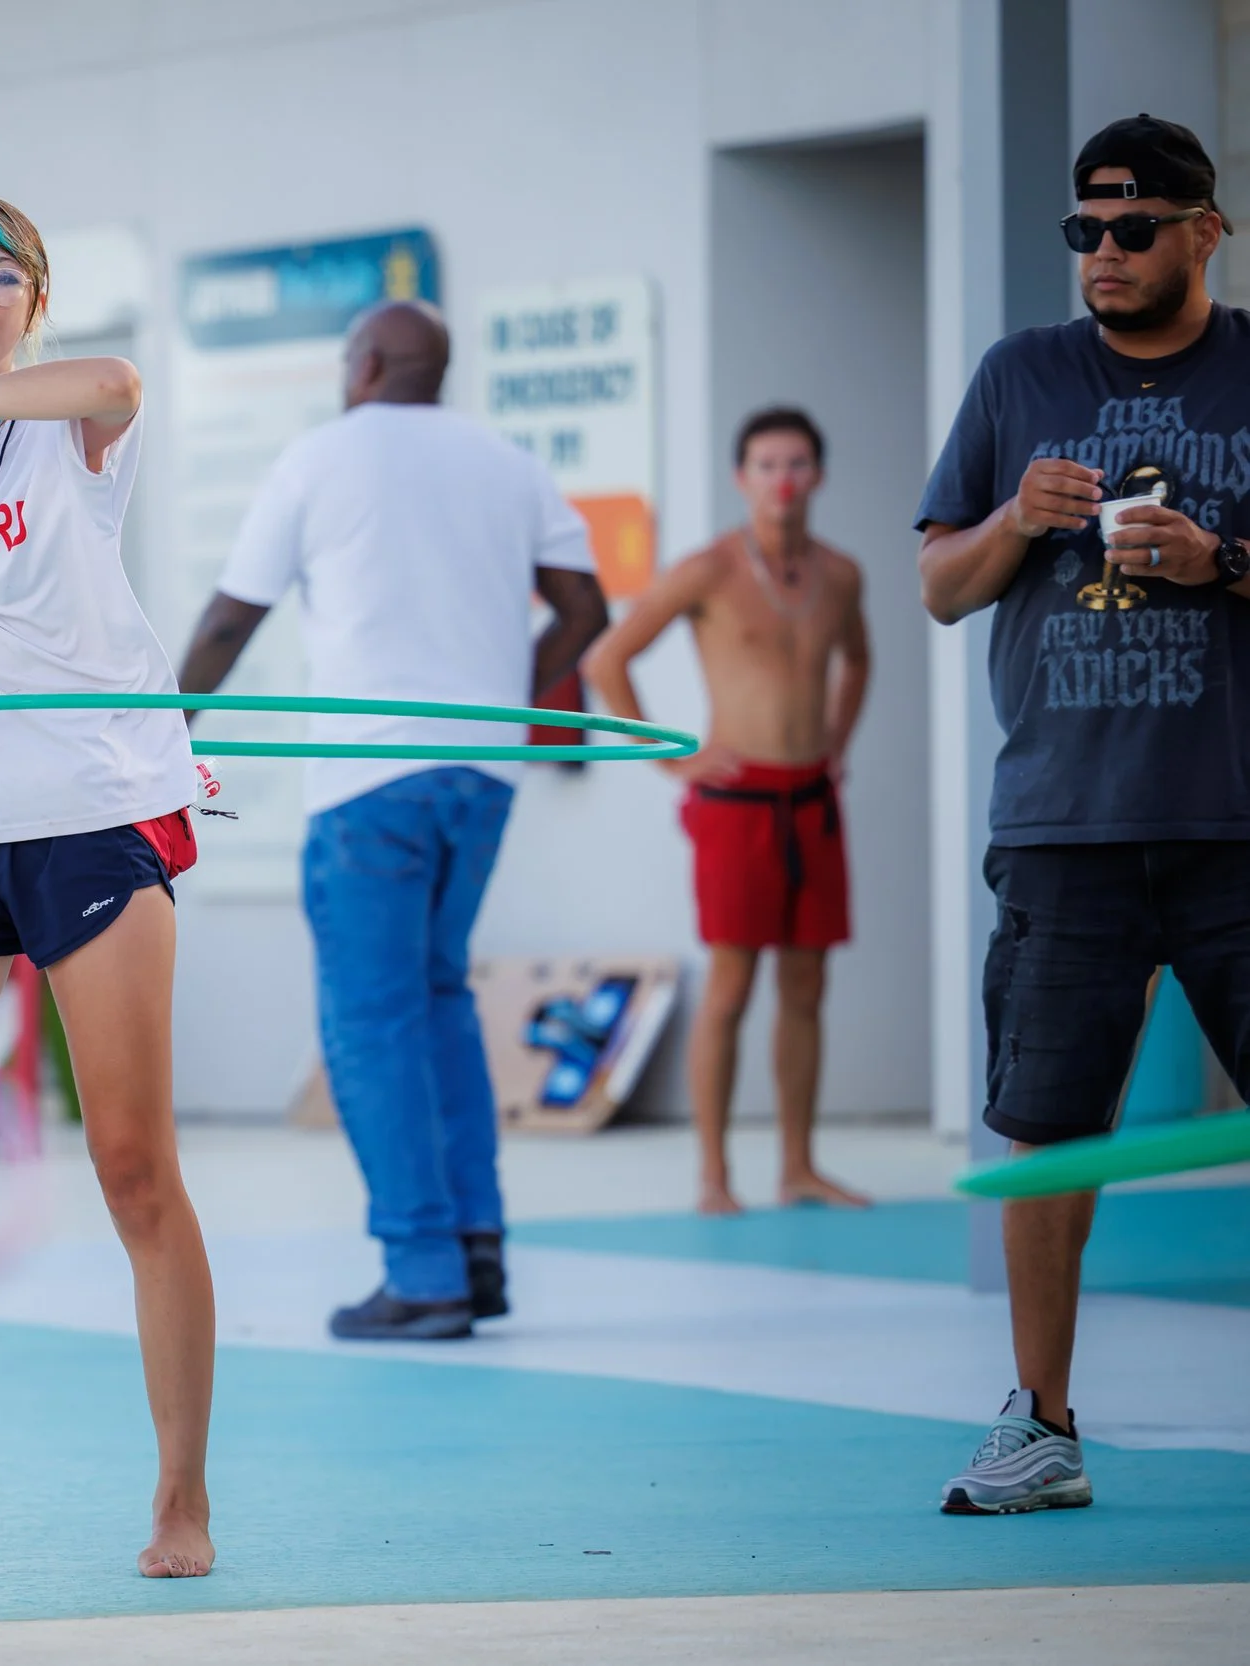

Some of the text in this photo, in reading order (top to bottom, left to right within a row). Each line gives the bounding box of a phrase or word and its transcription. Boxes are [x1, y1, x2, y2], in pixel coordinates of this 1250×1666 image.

[1098, 396, 1187, 432] NBA
[1030, 427, 1250, 503] AMPIONS
[1042, 608, 1212, 650] NEW YORK
[1041, 648, 1207, 712] KNICKS
